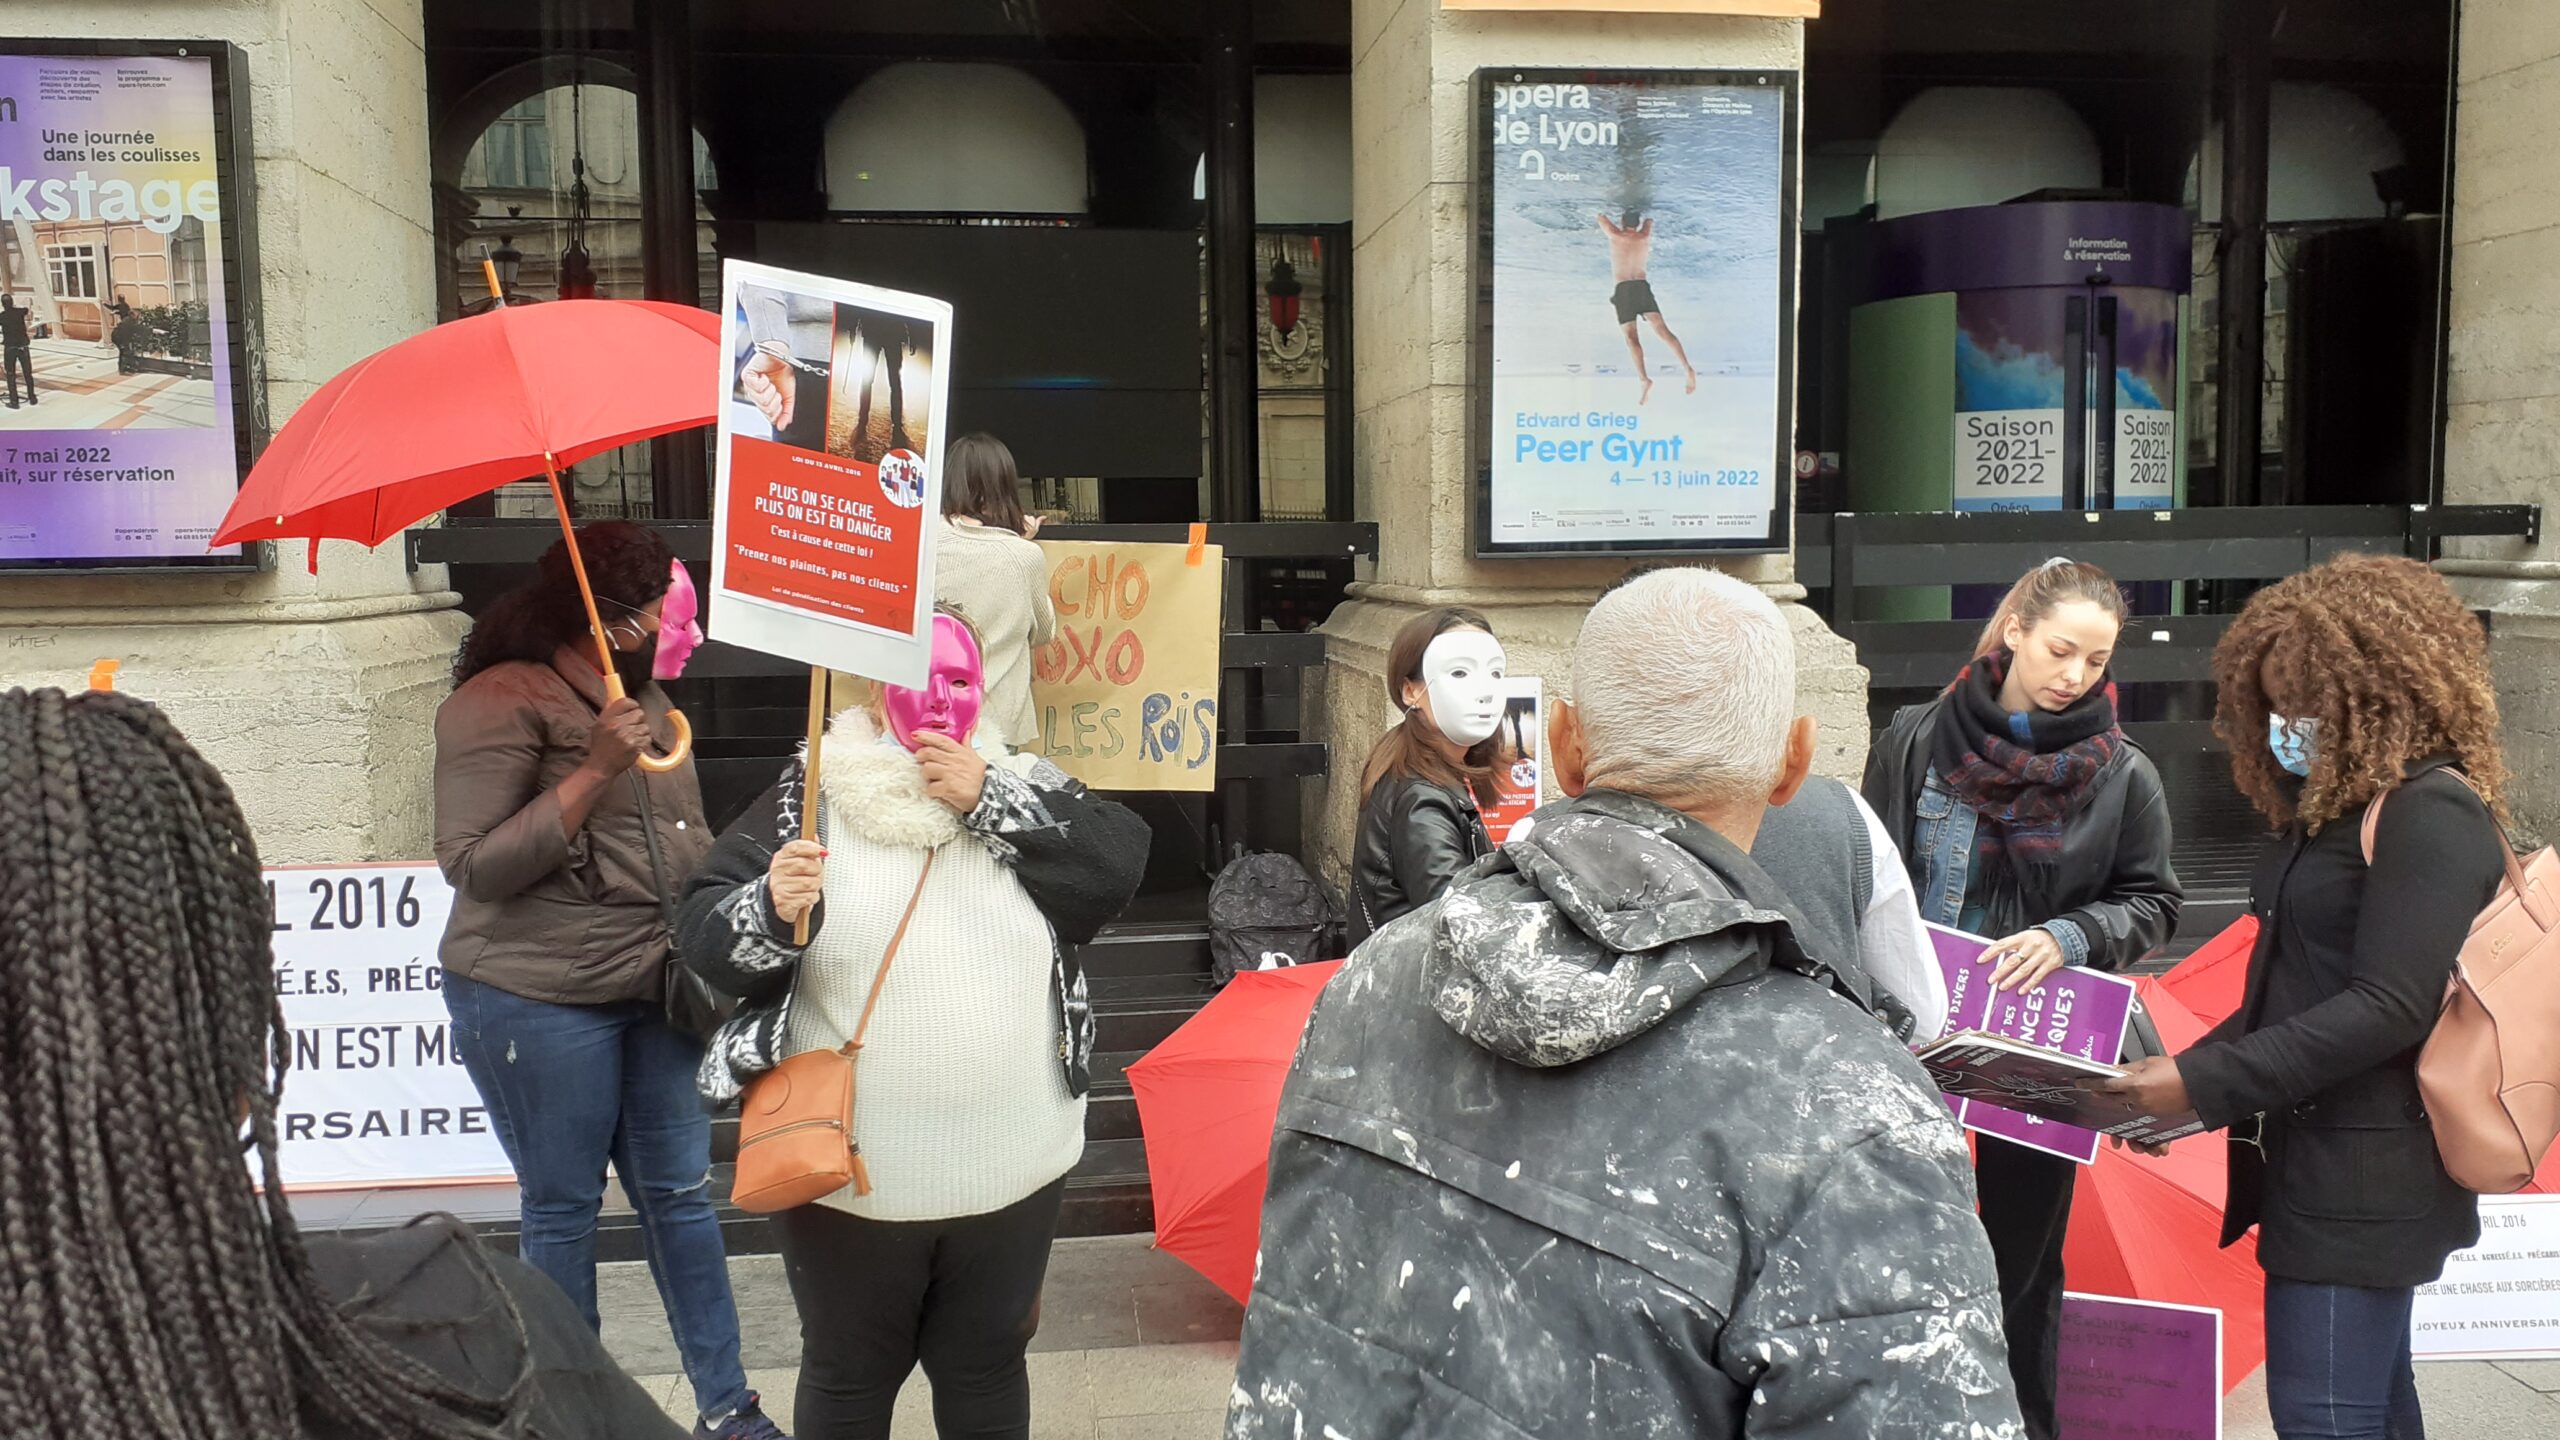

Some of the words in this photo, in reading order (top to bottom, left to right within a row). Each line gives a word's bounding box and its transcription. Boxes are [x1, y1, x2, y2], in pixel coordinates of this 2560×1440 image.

[42, 129, 79, 144] Une
[84, 129, 155, 147] journée
[1540, 113, 1618, 151] Lyon
[43, 147, 86, 162] dans
[91, 147, 116, 162] les
[121, 148, 200, 162] coulisses
[1551, 171, 1580, 182] Opéra
[0, 166, 219, 234] kstage
[2068, 237, 2127, 250] Information
[2063, 250, 2073, 262] &
[2075, 249, 2131, 262] réservation
[1516, 412, 1580, 428] Edvard
[1586, 412, 1638, 430] Grieg
[1967, 416, 2054, 438] Saison
[2123, 415, 2170, 438] Saison
[6, 448, 18, 463] 7
[24, 448, 59, 463] mai
[65, 447, 111, 463] 2022
[1515, 434, 1594, 463] Peer
[1601, 433, 1683, 467] Gynt
[1976, 439, 2056, 461] 2021-
[28, 469, 57, 482] sur
[64, 466, 175, 482] réservation
[791, 455, 804, 463] LOI
[804, 458, 815, 466] DU
[824, 462, 844, 473] AVRIL
[1976, 464, 2045, 486] 2022
[2130, 463, 2167, 484] 2022
[1610, 471, 1621, 486] 4
[1652, 471, 1672, 485] 13
[1677, 470, 1711, 488] juin
[1716, 470, 1759, 485] 2022
[769, 482, 799, 502] PLUS
[801, 490, 818, 507] ON
[821, 494, 835, 511] SE
[837, 498, 877, 522] CACHE,
[755, 496, 784, 517] PLUS
[787, 504, 803, 521] ON
[806, 509, 826, 526] EST
[829, 514, 844, 530] EN
[846, 518, 892, 542] DANGER
[770, 525, 791, 539] C'est
[792, 528, 798, 540] à
[799, 532, 822, 547] cause
[823, 537, 833, 549] de
[834, 540, 856, 554] cette
[857, 544, 868, 557] loi
[869, 548, 874, 559] !
[771, 554, 787, 567] nos
[789, 558, 830, 577] plaintes,
[831, 568, 847, 582] pas
[849, 572, 866, 585] nos
[868, 577, 900, 594] clients
[1051, 553, 1150, 621] CHO
[782, 588, 791, 596] de
[830, 598, 842, 607] des
[842, 602, 864, 614] clients
[1043, 701, 1124, 759] LES
[309, 876, 421, 930] 2016
[277, 961, 348, 996] É.E.S,
[368, 957, 442, 992] PRÉC
[1950, 967, 1970, 1014] DIVERS
[2003, 1004, 2017, 1027] DES
[336, 1026, 402, 1070] EST
[285, 1106, 487, 1141] RSAIRE
[2480, 1215, 2500, 1229] RIL
[2502, 1214, 2527, 1228] 2016
[2415, 1283, 2438, 1296] CORE
[2440, 1283, 2457, 1295] UNE
[2460, 1281, 2494, 1294] CHASSE
[2496, 1281, 2514, 1293] AUX
[2515, 1278, 2560, 1292] SORCIÈRES
[2416, 1321, 2466, 1331] JOYEUX
[2471, 1319, 2560, 1330] ANNIVERSAIR
